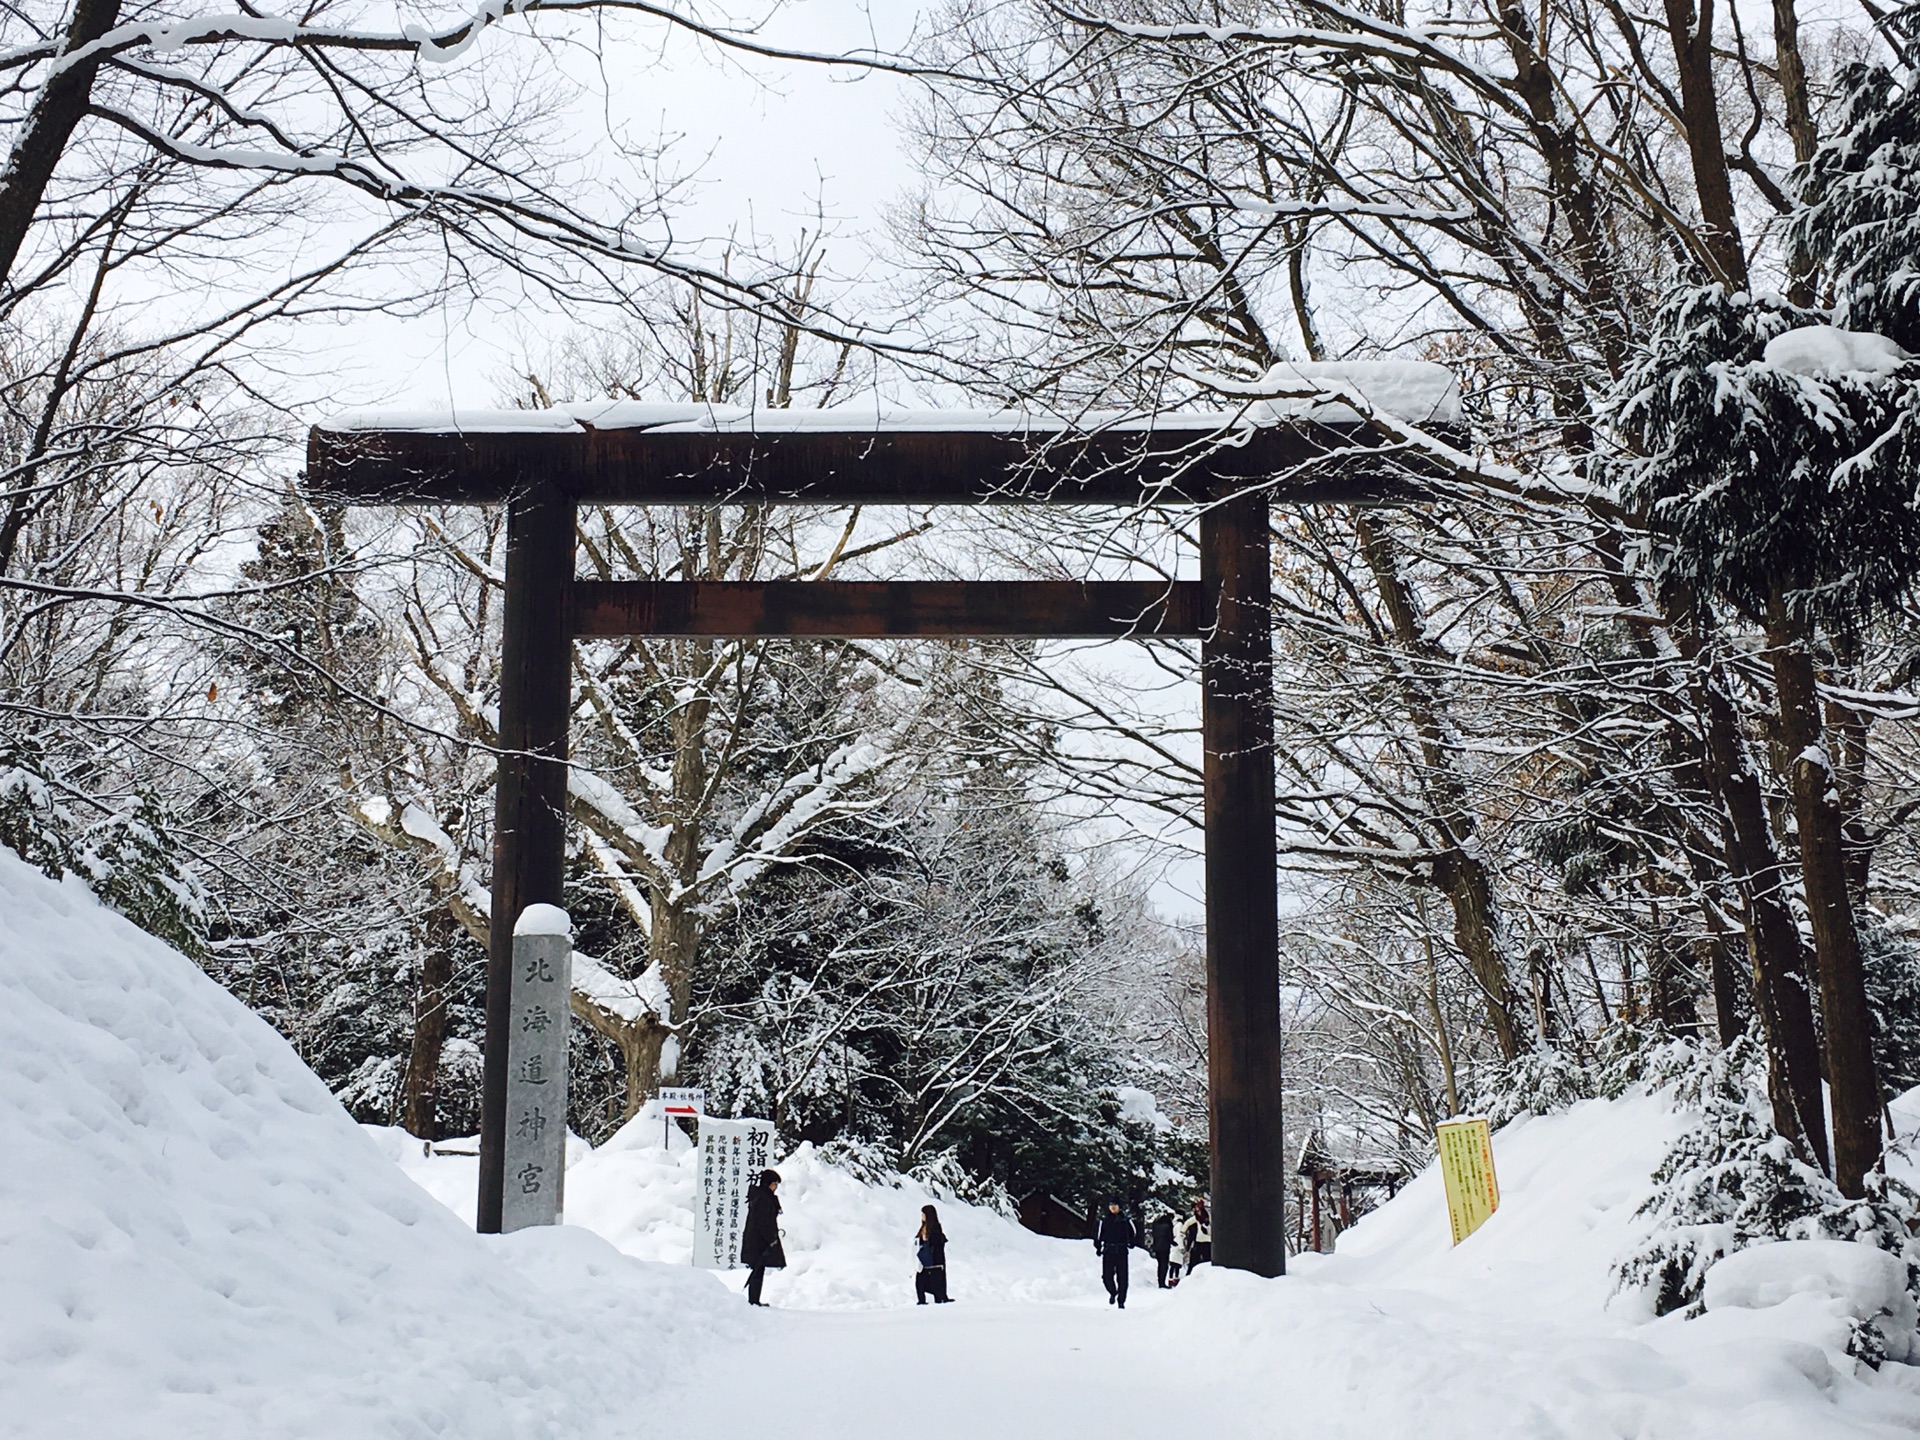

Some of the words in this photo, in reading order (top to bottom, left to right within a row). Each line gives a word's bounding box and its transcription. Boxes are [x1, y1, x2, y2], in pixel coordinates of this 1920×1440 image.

[516, 957, 554, 1195] 北海道神宮
